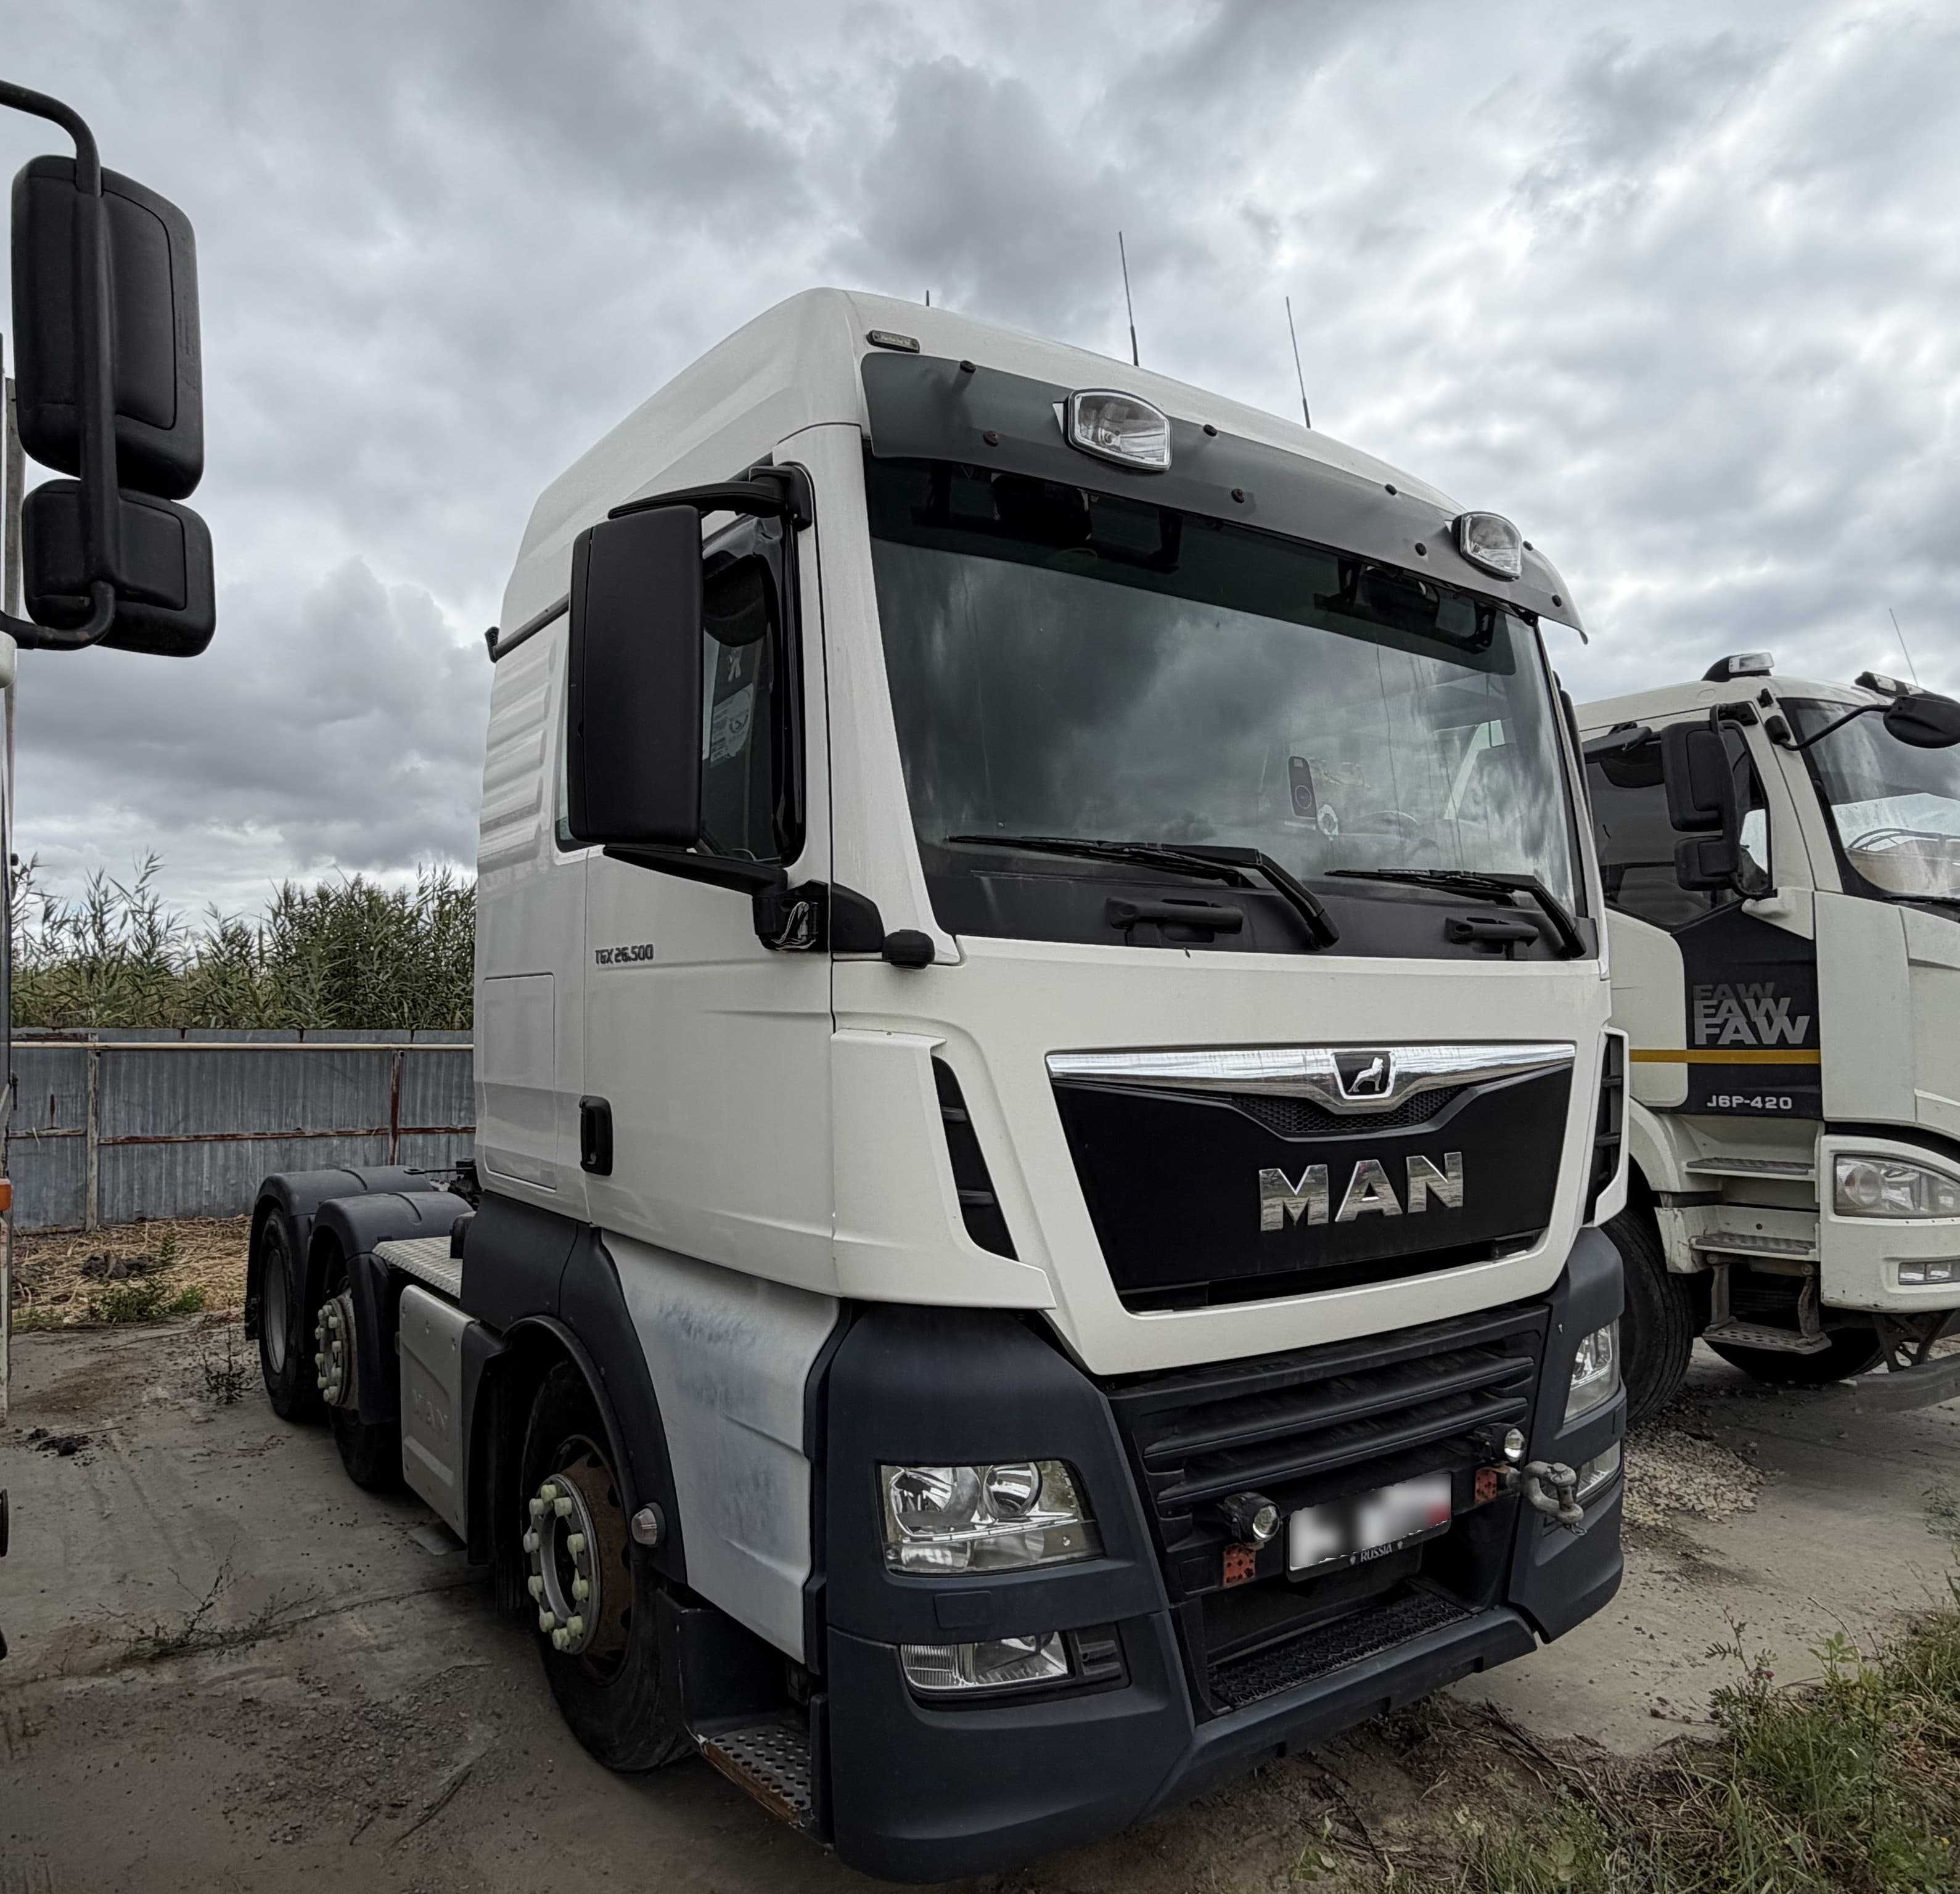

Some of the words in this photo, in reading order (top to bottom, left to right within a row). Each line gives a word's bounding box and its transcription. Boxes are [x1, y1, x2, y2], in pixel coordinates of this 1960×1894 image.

[595, 948, 613, 965] TGX
[614, 943, 654, 963] 26.500
[1694, 982, 1775, 1002] FAW
[1694, 997, 1791, 1022] FAW
[1694, 1015, 1811, 1045] FAW
[1707, 1094, 1792, 1110] J6P-420
[1258, 1151, 1464, 1232] MAN
[1360, 1543, 1393, 1563] RUSSIA
